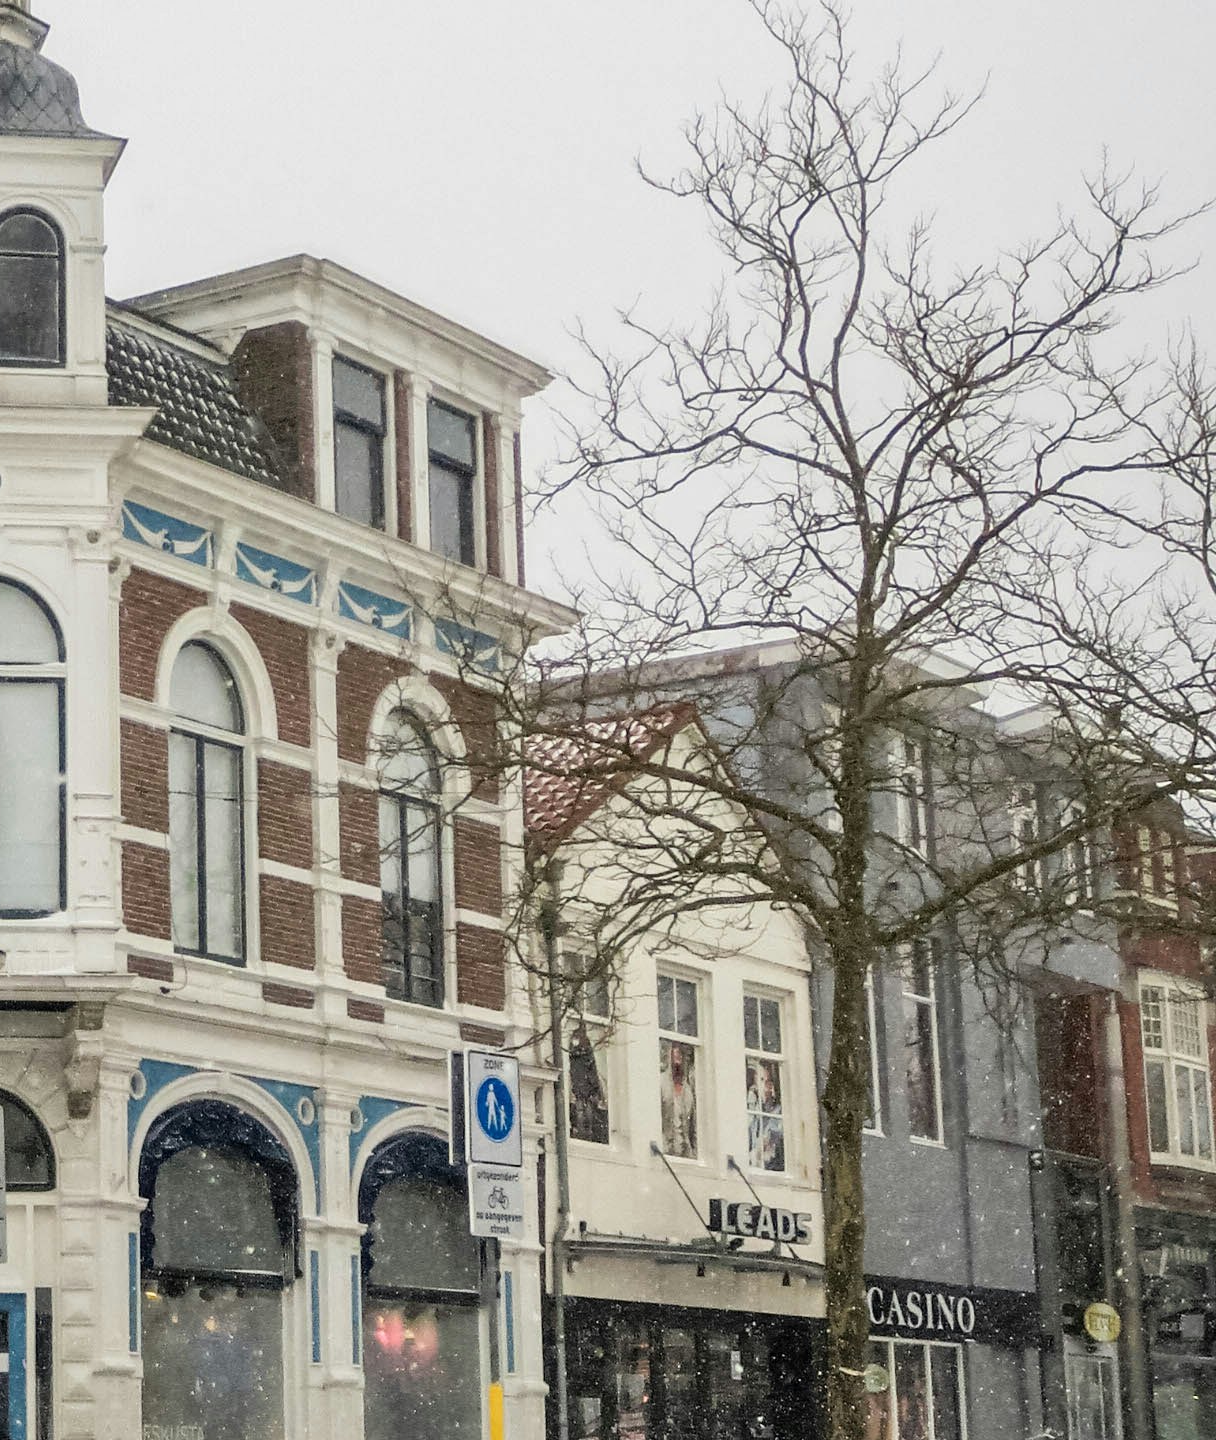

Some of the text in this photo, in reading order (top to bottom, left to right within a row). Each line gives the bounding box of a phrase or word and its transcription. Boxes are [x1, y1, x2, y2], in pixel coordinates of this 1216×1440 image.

[484, 1059, 504, 1070] ZONE
[710, 1198, 813, 1245] LEADS
[866, 1286, 976, 1333] CASINO
